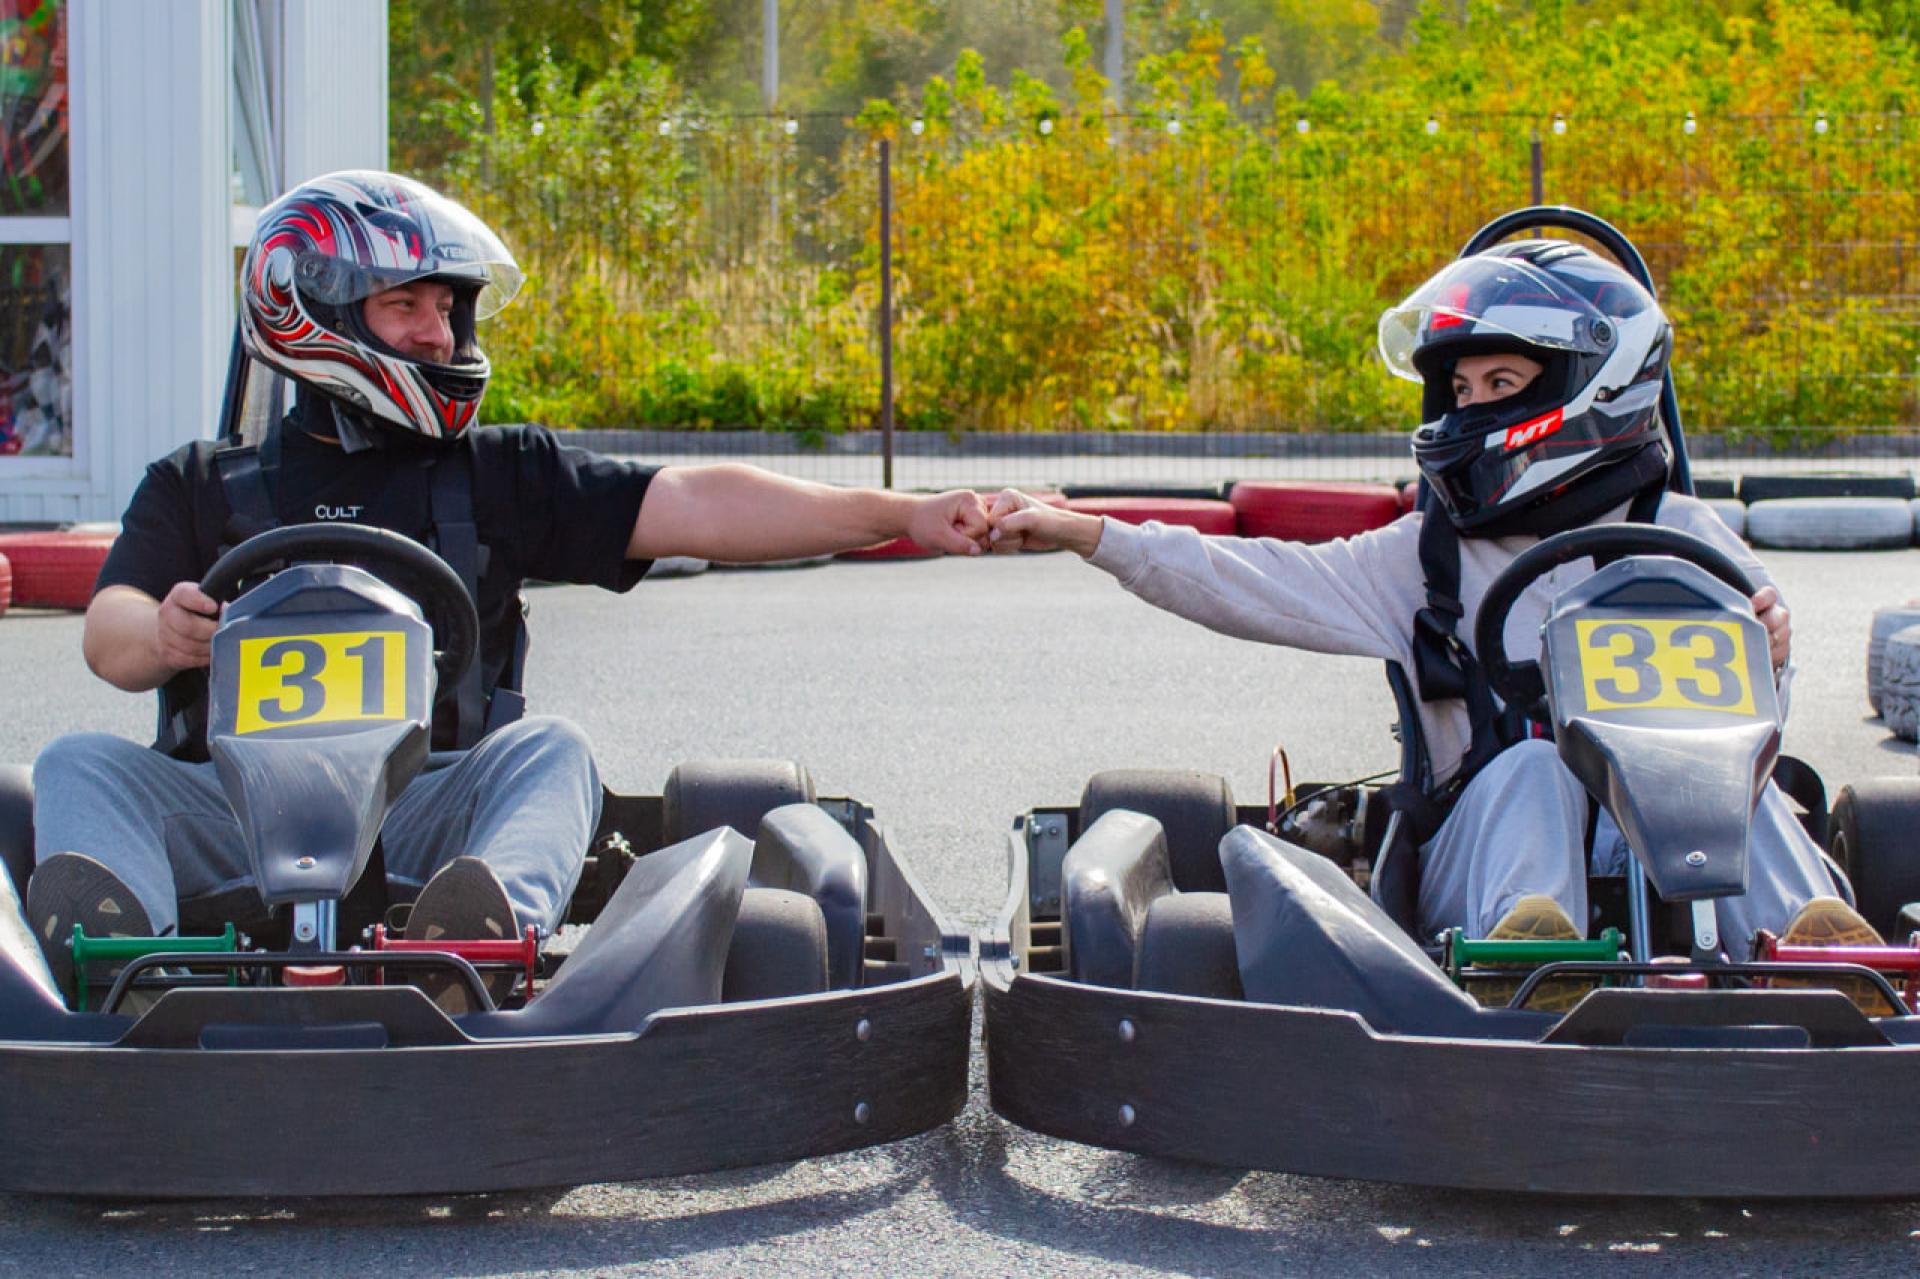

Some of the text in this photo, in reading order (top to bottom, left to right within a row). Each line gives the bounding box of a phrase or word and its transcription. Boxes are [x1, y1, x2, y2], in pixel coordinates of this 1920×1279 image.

[1509, 413, 1560, 447] MT
[314, 504, 362, 520] CULT
[257, 636, 386, 723] 31
[1588, 623, 1743, 708] 33
